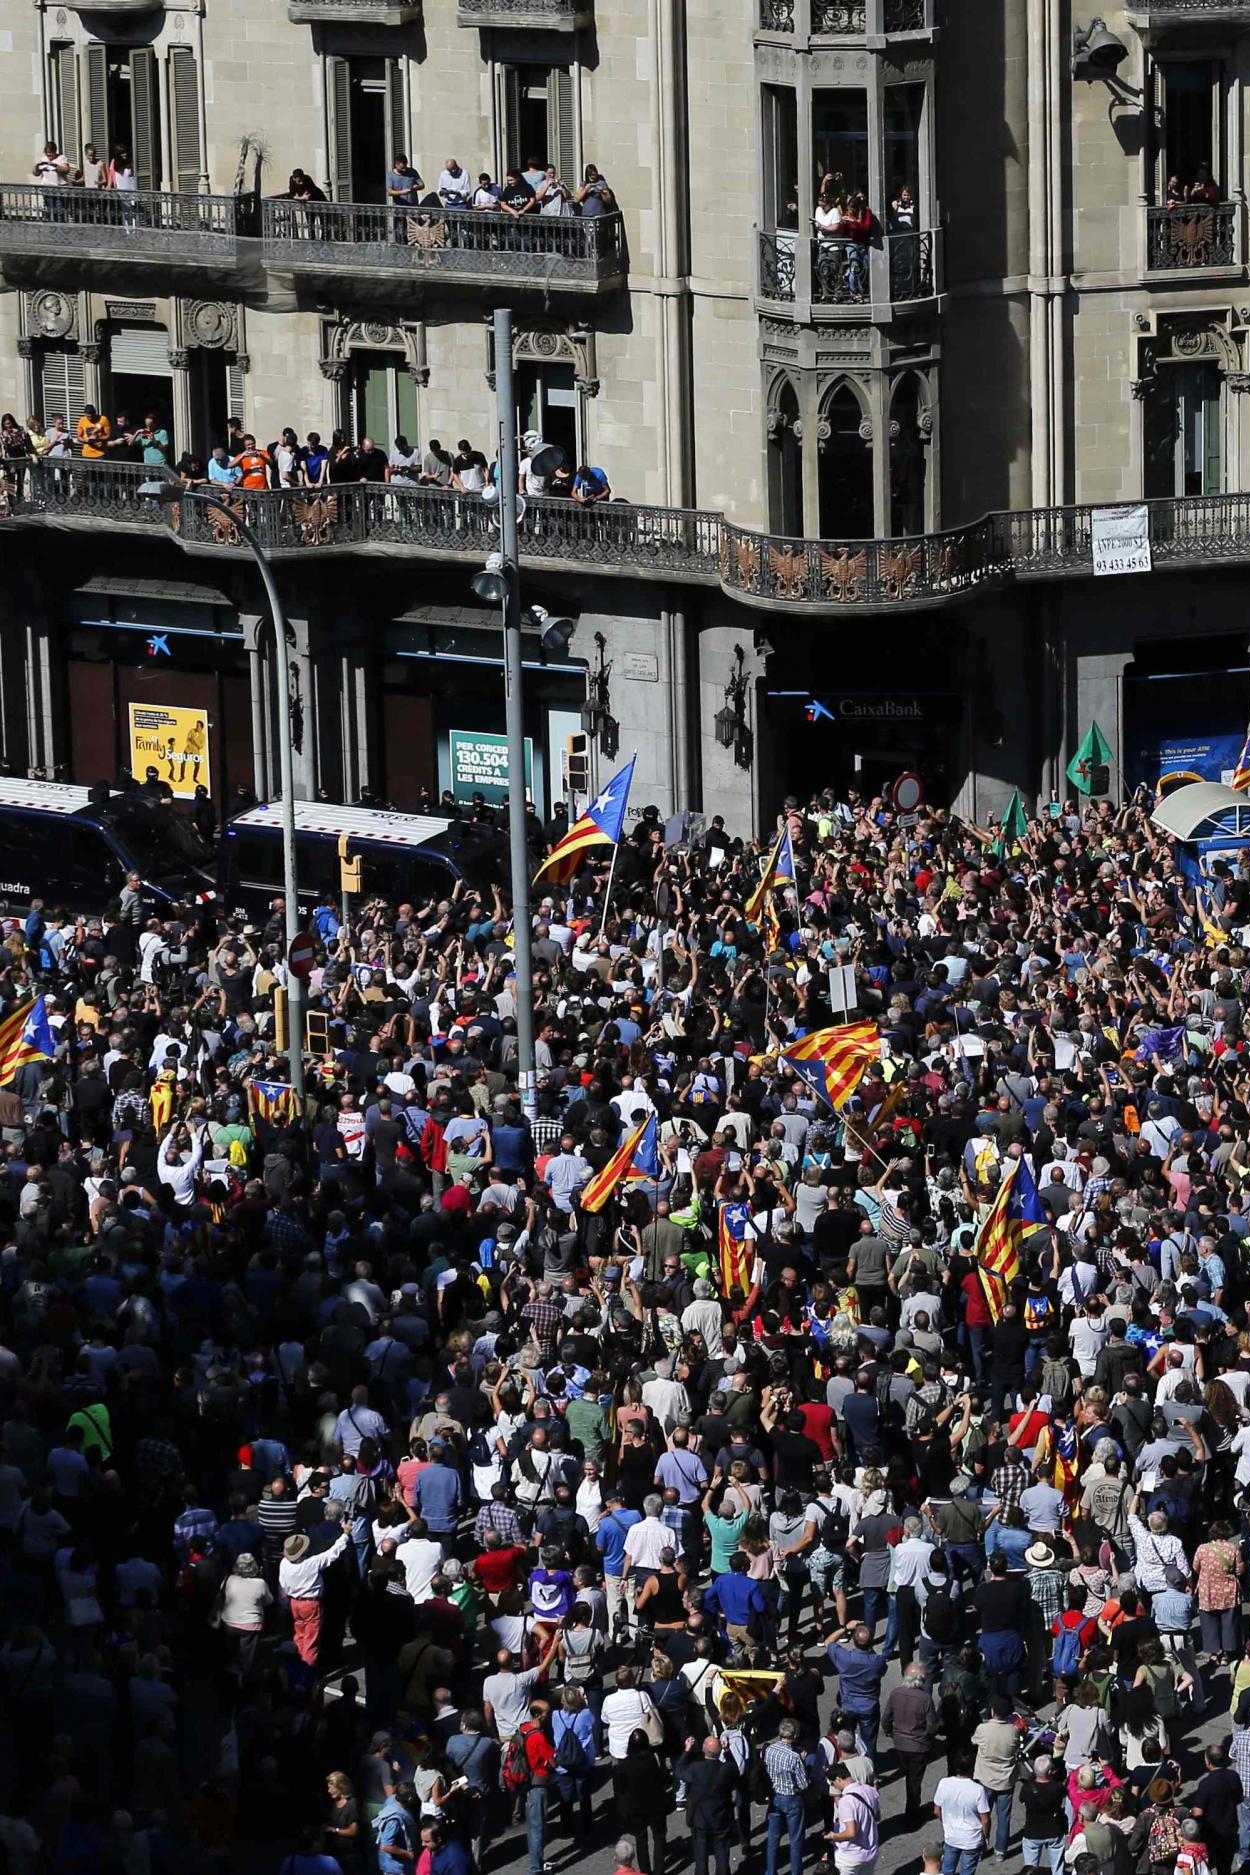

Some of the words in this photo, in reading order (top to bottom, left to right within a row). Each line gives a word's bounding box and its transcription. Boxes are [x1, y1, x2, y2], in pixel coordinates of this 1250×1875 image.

[1096, 560, 1107, 571] 93
[1109, 558, 1124, 571] 433
[1127, 557, 1137, 569] 45
[1139, 556, 1149, 568] 63
[839, 699, 924, 716] CaixaBank
[135, 736, 166, 759] Family
[456, 741, 474, 751] PER
[475, 743, 509, 754] CONCED
[165, 749, 204, 763] Seguros
[456, 751, 509, 768] 130.504
[494, 768, 501, 776] A
[457, 773, 473, 783] LES
[475, 775, 510, 786] EMPRES
